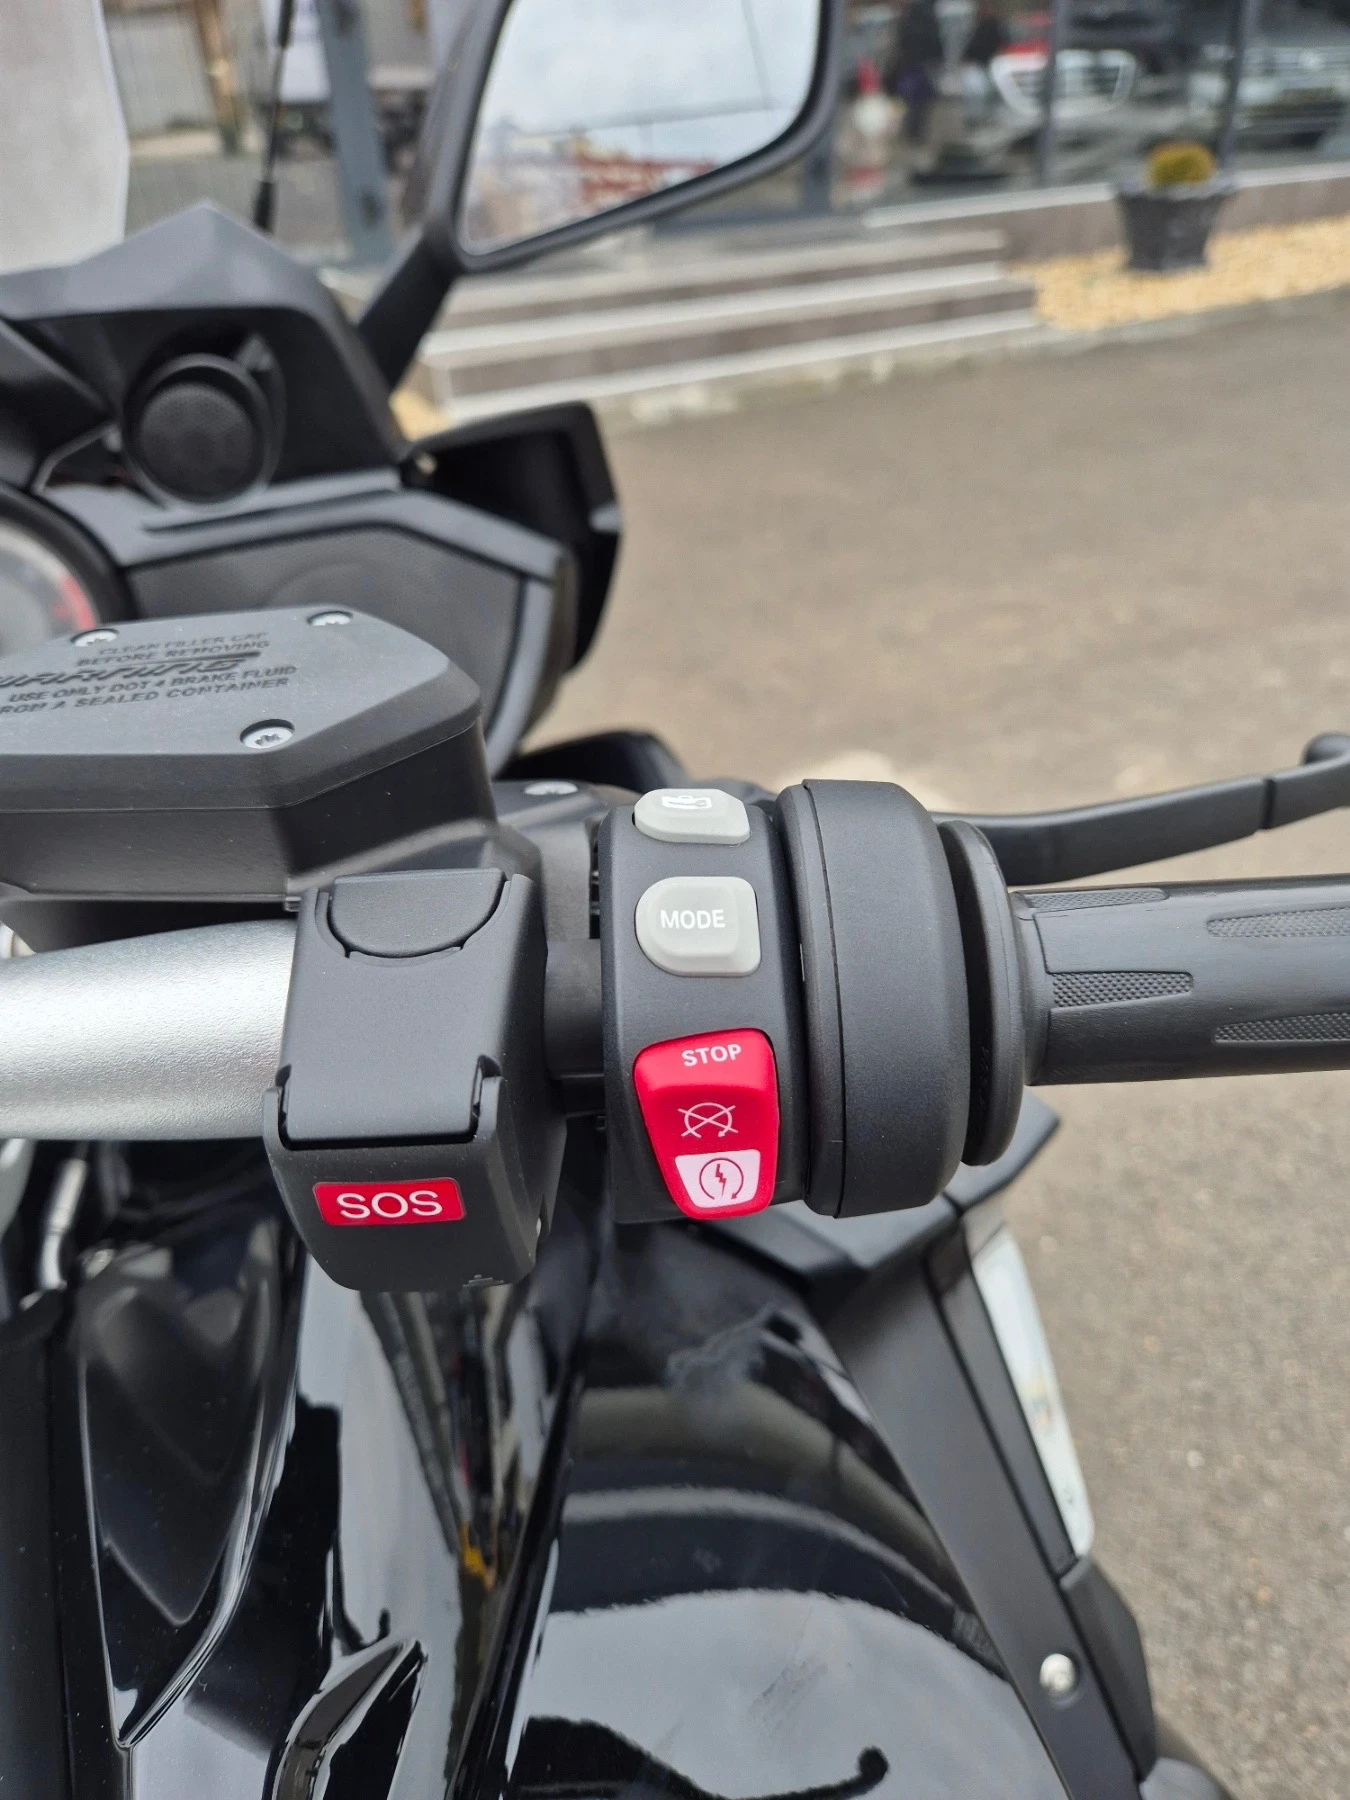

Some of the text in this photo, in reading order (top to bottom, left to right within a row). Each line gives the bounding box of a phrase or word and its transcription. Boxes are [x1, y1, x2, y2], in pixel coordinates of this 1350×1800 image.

[76, 640, 270, 667] BEFORE REMOVING
[0, 702, 48, 714] ROM
[73, 690, 160, 707] SEALED
[165, 677, 290, 699] CONTAINER
[9, 690, 50, 703] USE
[52, 685, 106, 699] ONLY
[109, 681, 152, 693] DOT
[170, 672, 240, 687] BRAKE
[242, 665, 297, 679] FLUID
[660, 909, 726, 929] MODE
[681, 1044, 742, 1067] STOP
[336, 1190, 443, 1219] SOS
